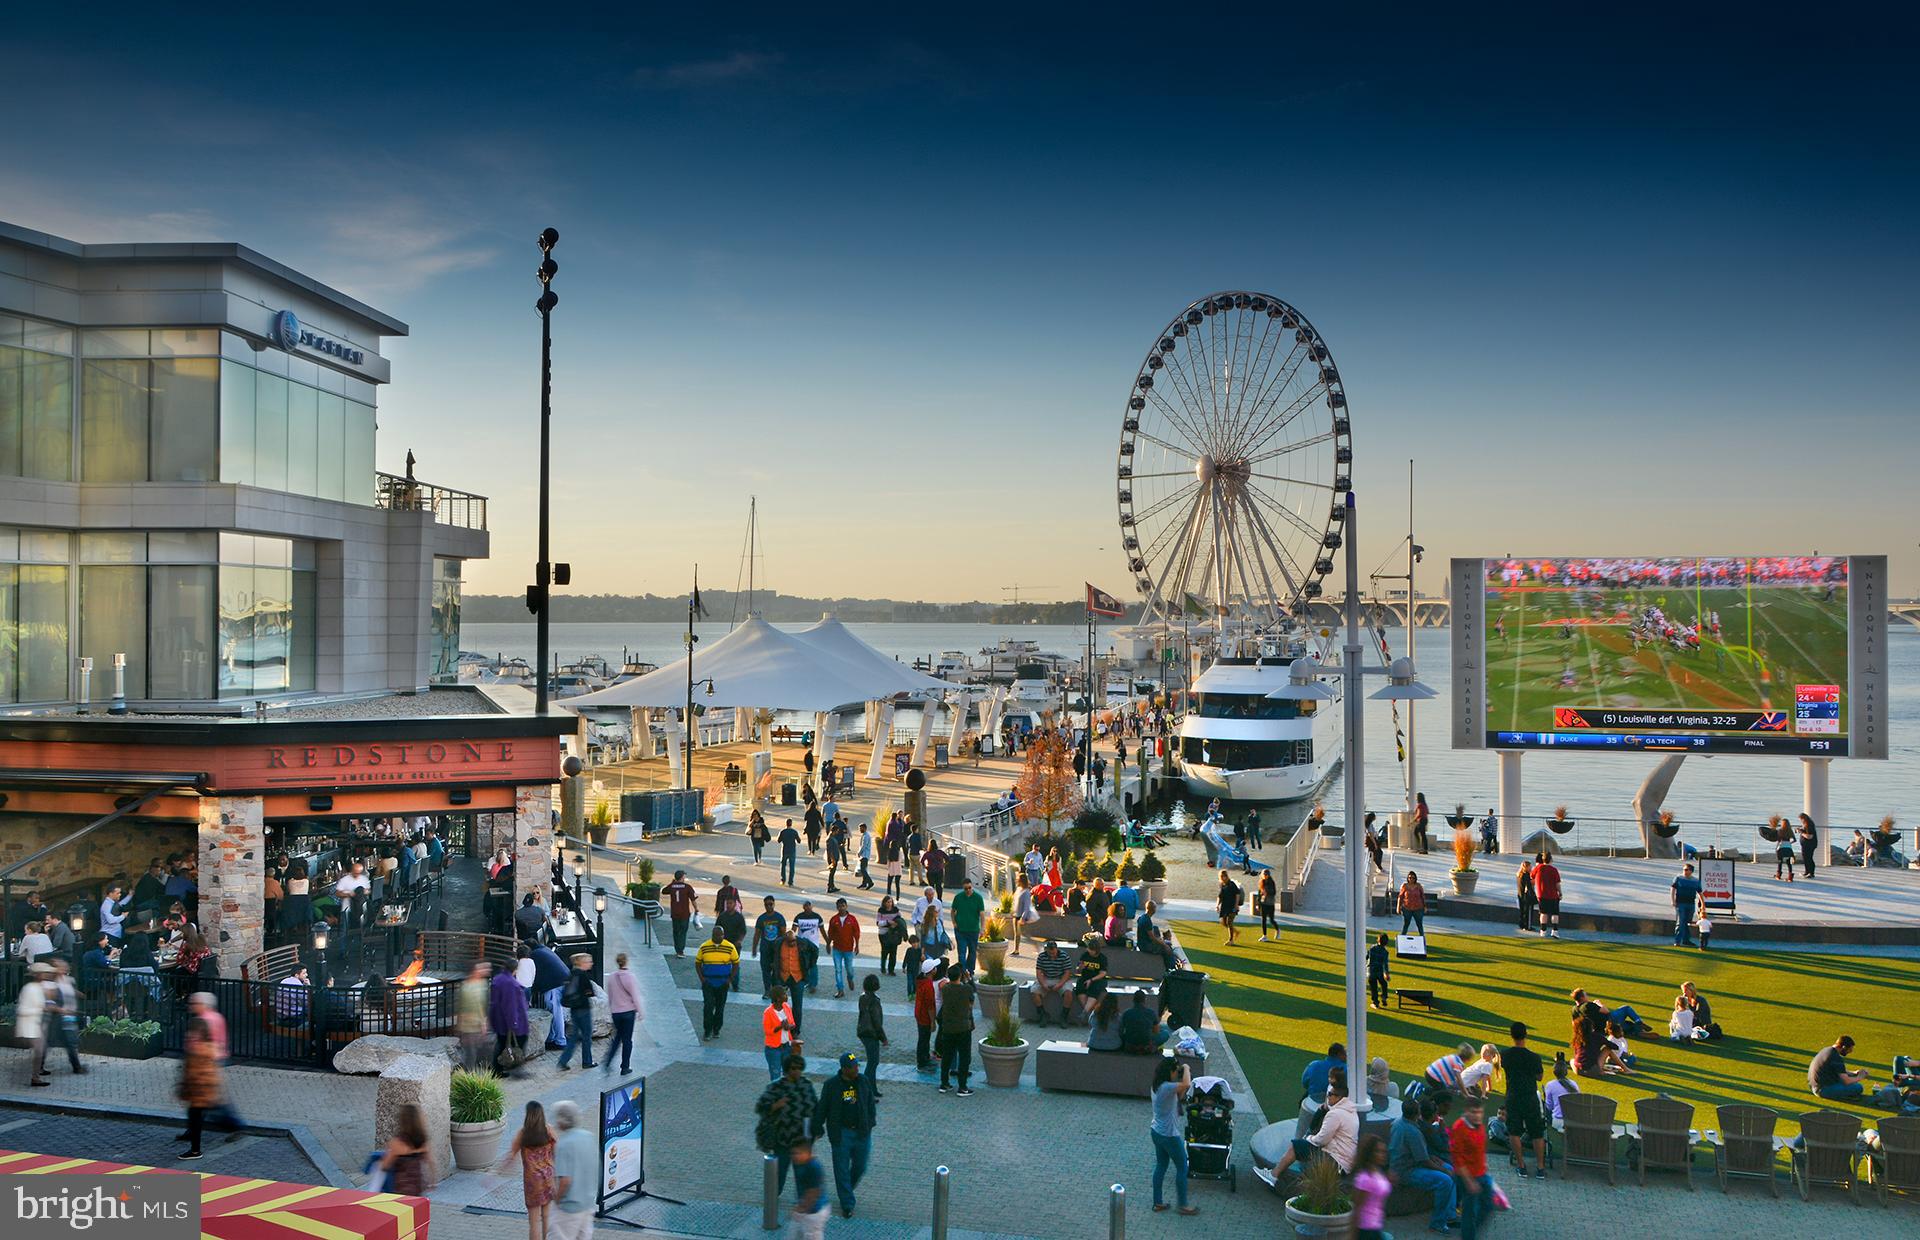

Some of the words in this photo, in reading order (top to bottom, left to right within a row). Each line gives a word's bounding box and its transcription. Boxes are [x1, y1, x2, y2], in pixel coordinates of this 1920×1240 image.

[300, 329, 363, 365] SPARTAN
[1464, 573, 1472, 650] NATIONAL
[1865, 572, 1875, 653] NATIONAL
[1798, 694, 1810, 702] 24
[1464, 677, 1472, 735] HARBOR
[1602, 713, 1617, 724] (5)
[1618, 714, 1657, 724] Louisville
[1658, 714, 1675, 724] def.
[1676, 715, 1711, 726] Virginia,
[1712, 716, 1737, 725] 32-25
[1798, 710, 1810, 718] 25
[1866, 683, 1875, 744] HARBOR
[1693, 738, 1705, 746] 38
[1809, 741, 1830, 750] FS1
[267, 741, 514, 769] REDSTONE
[342, 772, 403, 781] AMERICAN
[411, 771, 445, 780] GRILL
[675, 890, 680, 902] 1
